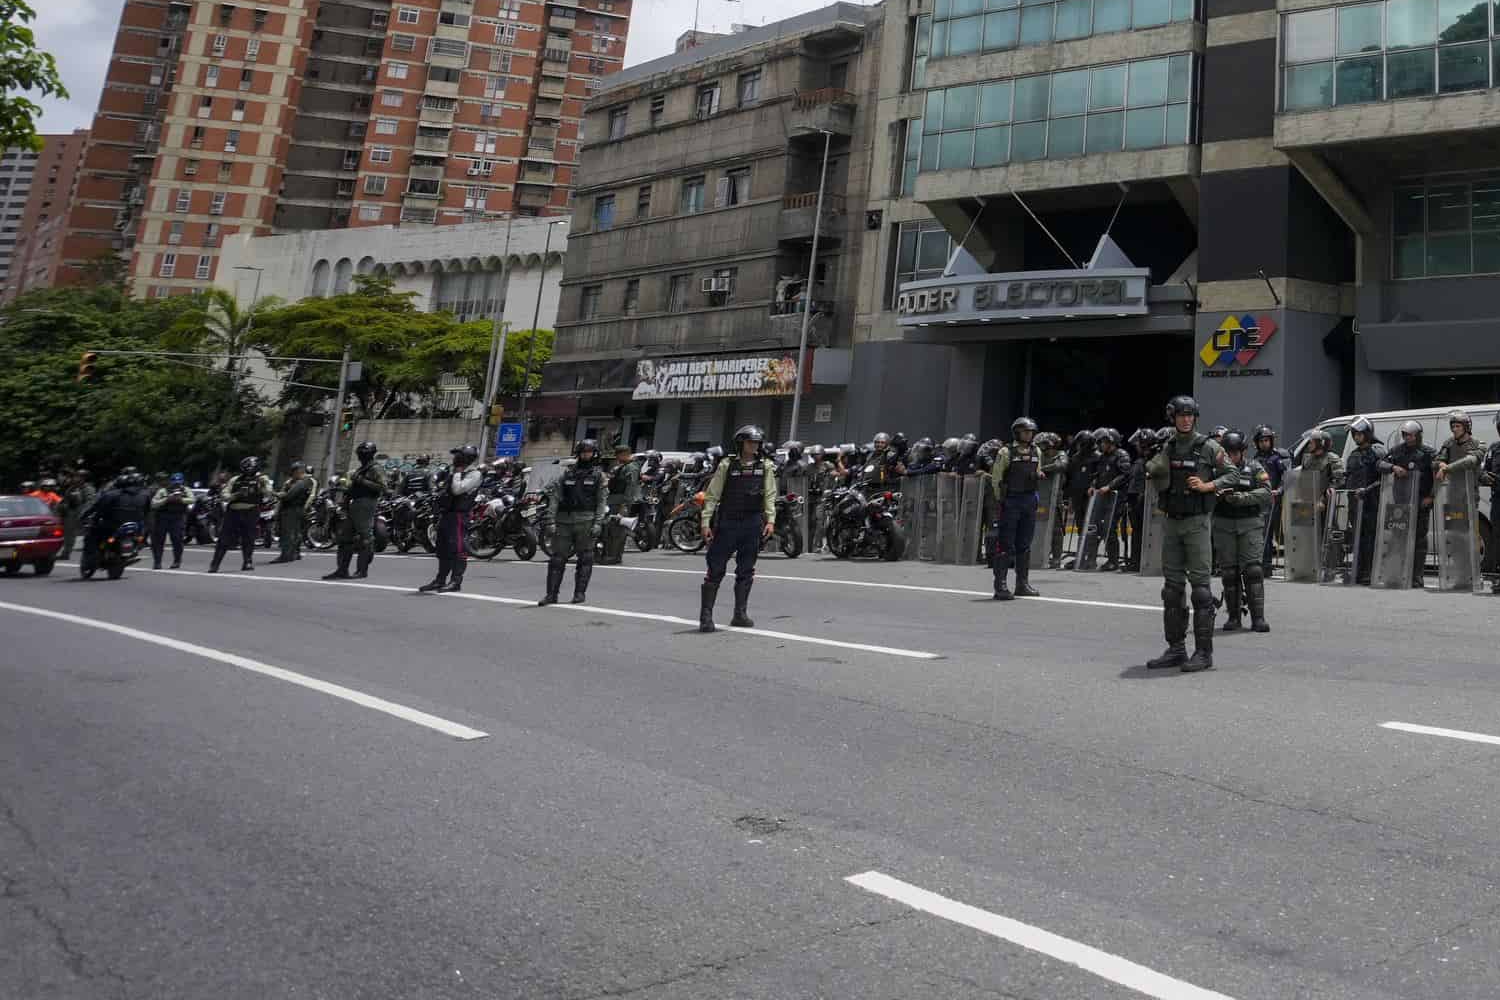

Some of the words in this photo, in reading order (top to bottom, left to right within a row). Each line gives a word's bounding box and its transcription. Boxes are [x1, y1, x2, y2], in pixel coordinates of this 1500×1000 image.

[899, 289, 956, 312] PODER
[973, 279, 1143, 310] ELECTORAL
[671, 375, 701, 392] POLLO
[718, 372, 762, 390] BRASAS
